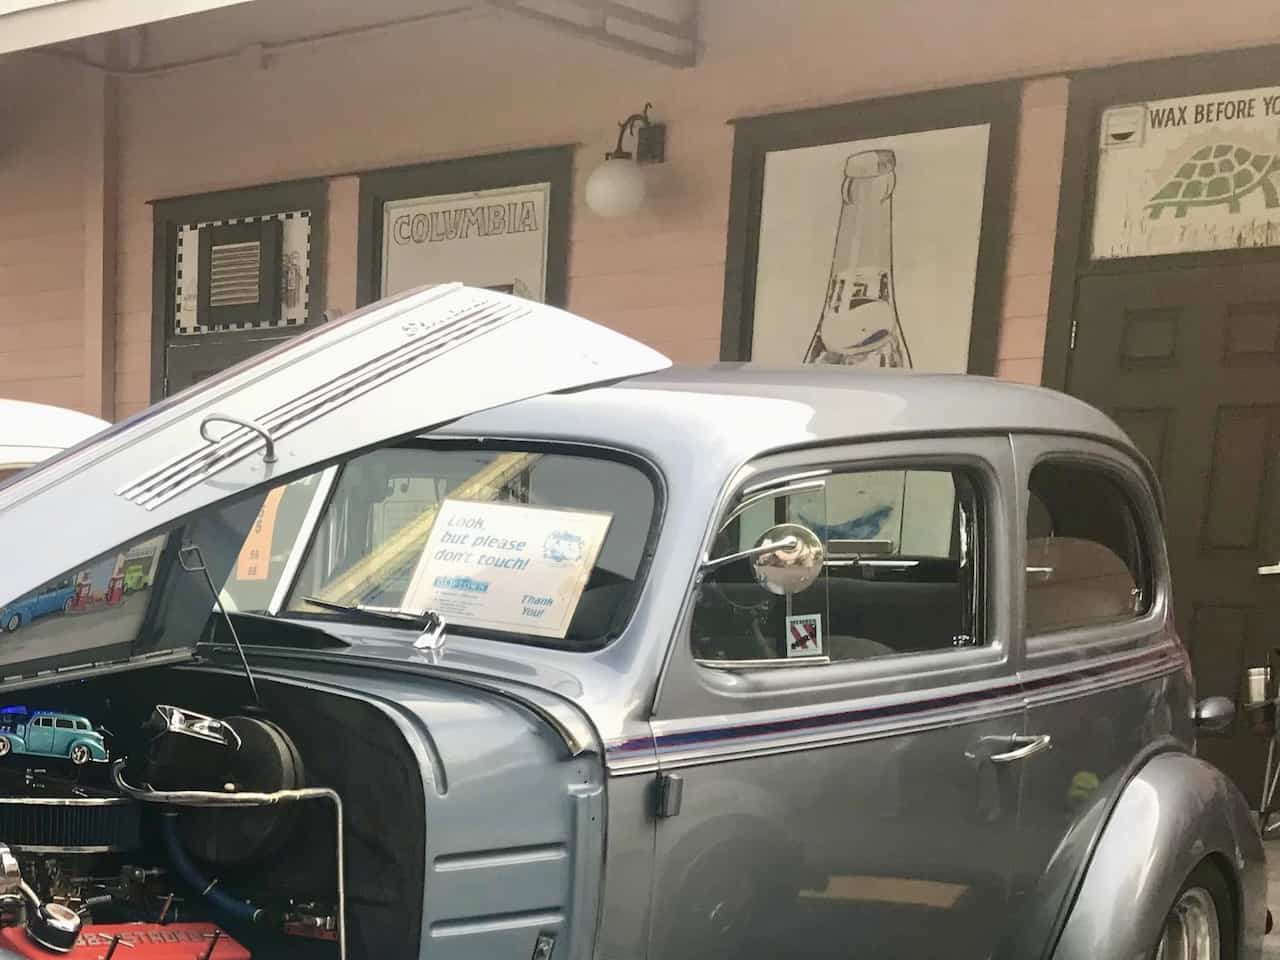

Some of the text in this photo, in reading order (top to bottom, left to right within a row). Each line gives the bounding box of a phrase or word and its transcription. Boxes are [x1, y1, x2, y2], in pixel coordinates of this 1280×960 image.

[1150, 105, 1187, 129] WAX
[1194, 98, 1256, 124] BEFORE
[393, 201, 539, 246] COLUMBIA
[440, 531, 527, 551] but please
[434, 548, 530, 571] don't touch!
[521, 594, 553, 607] Thank
